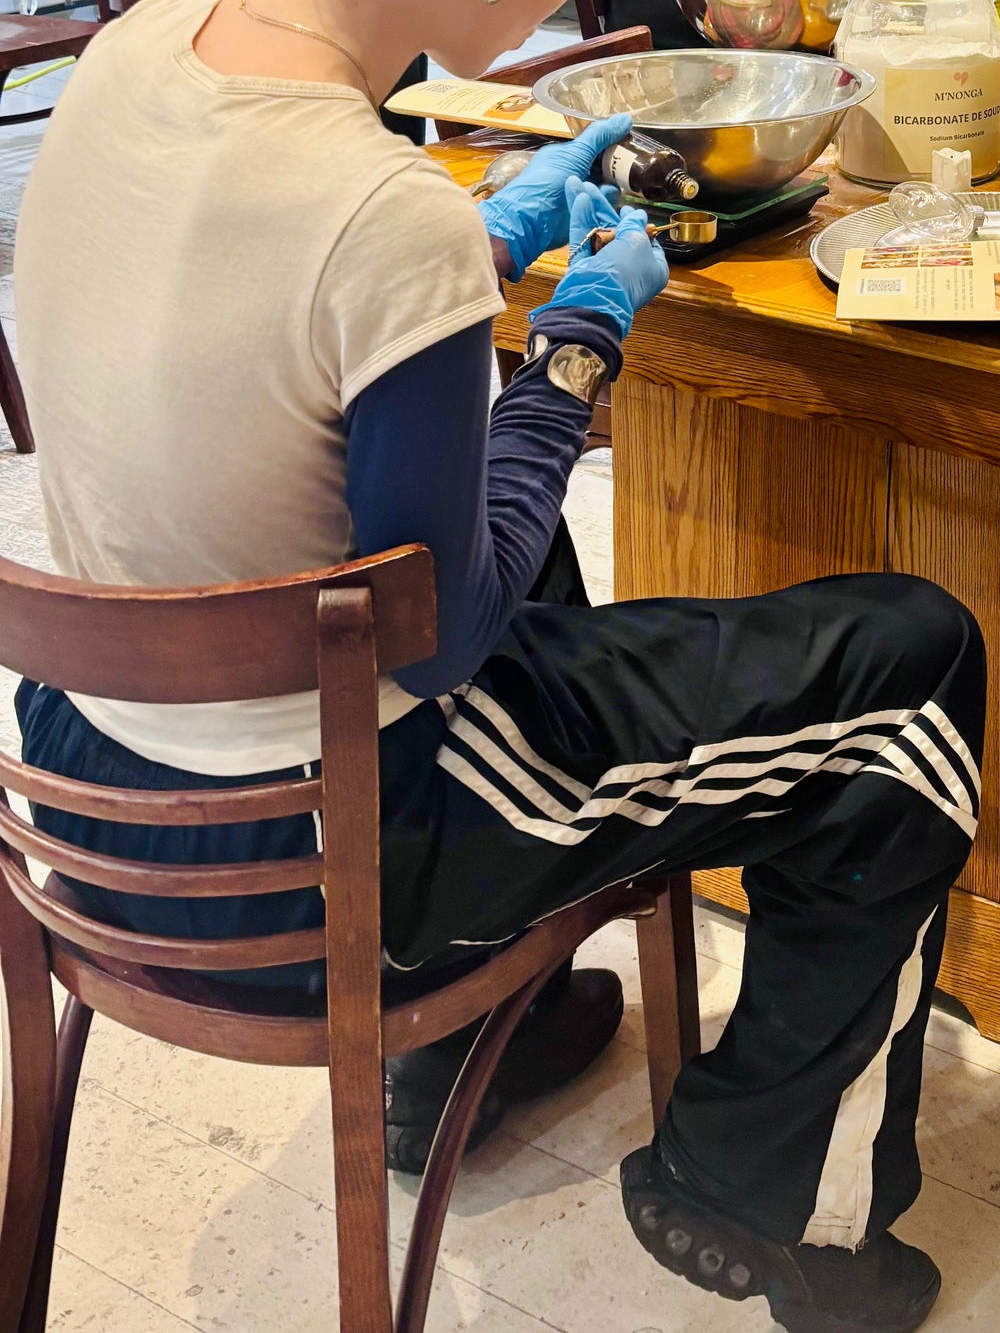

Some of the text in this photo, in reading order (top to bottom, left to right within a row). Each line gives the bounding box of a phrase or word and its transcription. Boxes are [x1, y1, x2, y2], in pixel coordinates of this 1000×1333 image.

[934, 88, 983, 102] M'NONGA
[894, 113, 969, 126] BICARBONATE
[971, 111, 982, 122] DE
